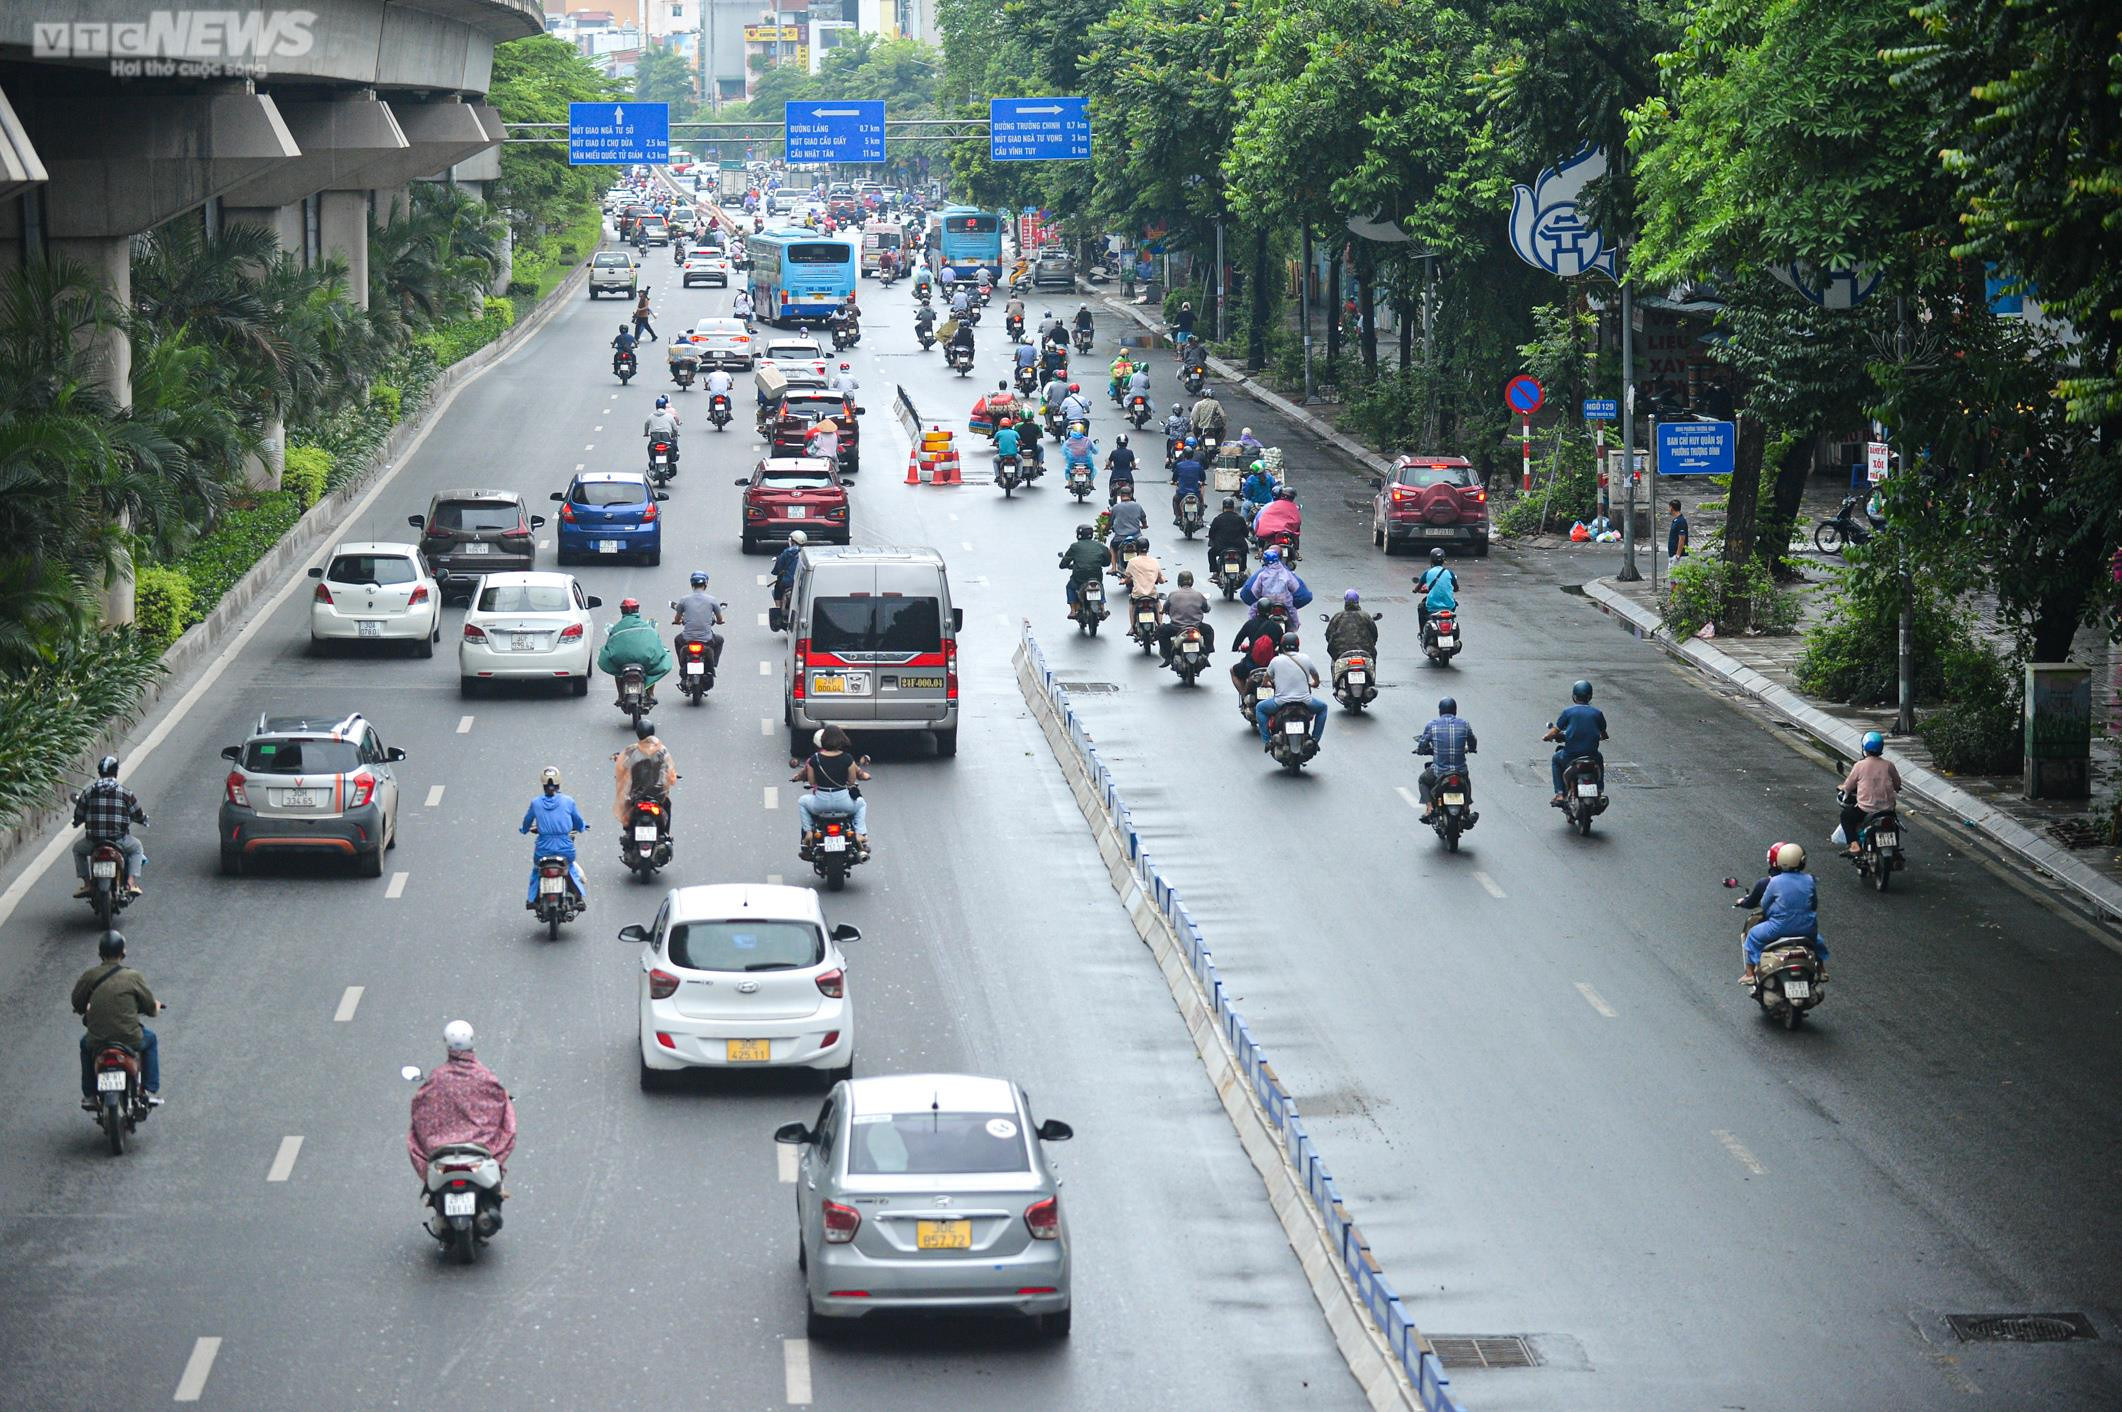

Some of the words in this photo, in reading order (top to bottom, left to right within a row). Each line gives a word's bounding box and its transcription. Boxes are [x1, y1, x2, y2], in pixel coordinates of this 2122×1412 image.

[572, 125, 584, 134] NÚT
[601, 126, 613, 134] NGÃ
[790, 123, 810, 132] ĐƯỜNG
[812, 123, 828, 132] LÁNG
[994, 121, 1014, 130] ĐƯỜNG
[1017, 120, 1040, 130] TRƯỜNG
[572, 138, 584, 147] NÚT
[607, 139, 618, 148] CHỢ
[657, 139, 666, 147] km
[790, 136, 802, 146] NÚT
[804, 138, 818, 146] GIAO
[820, 136, 832, 144] CẦU
[833, 134, 846, 144] GIẤY
[995, 133, 1006, 143] NÚT
[1008, 135, 1022, 143] GIAO
[1023, 134, 1035, 142] NGÃ
[1037, 134, 1045, 142] TƯ
[1047, 134, 1062, 144] VỌNG
[573, 150, 584, 160] VĂN
[585, 150, 600, 160] MIẾU
[601, 150, 617, 160] QUỐC
[628, 150, 642, 160] GIÁM
[790, 148, 802, 158] CẦU
[804, 148, 820, 158] NHẬT
[822, 149, 834, 158] TÂN
[995, 145, 1006, 156] CẦU
[1009, 146, 1022, 155] VĨNH
[1586, 400, 1600, 410] NGÕ
[1602, 402, 1614, 410] 129
[1667, 436, 1678, 446] BAN
[1690, 436, 1700, 445] HUY
[1700, 434, 1716, 446] QUÂN
[1717, 435, 1724, 446] SỰ
[1672, 446, 1690, 456] PHƯỜNG
[1691, 447, 1708, 457] THƯỢNG
[1709, 444, 1720, 455] ĐÌNH
[1873, 458, 1884, 469] XÔI
[732, 1050, 764, 1060] 425.11
[932, 1221, 956, 1232] 30E
